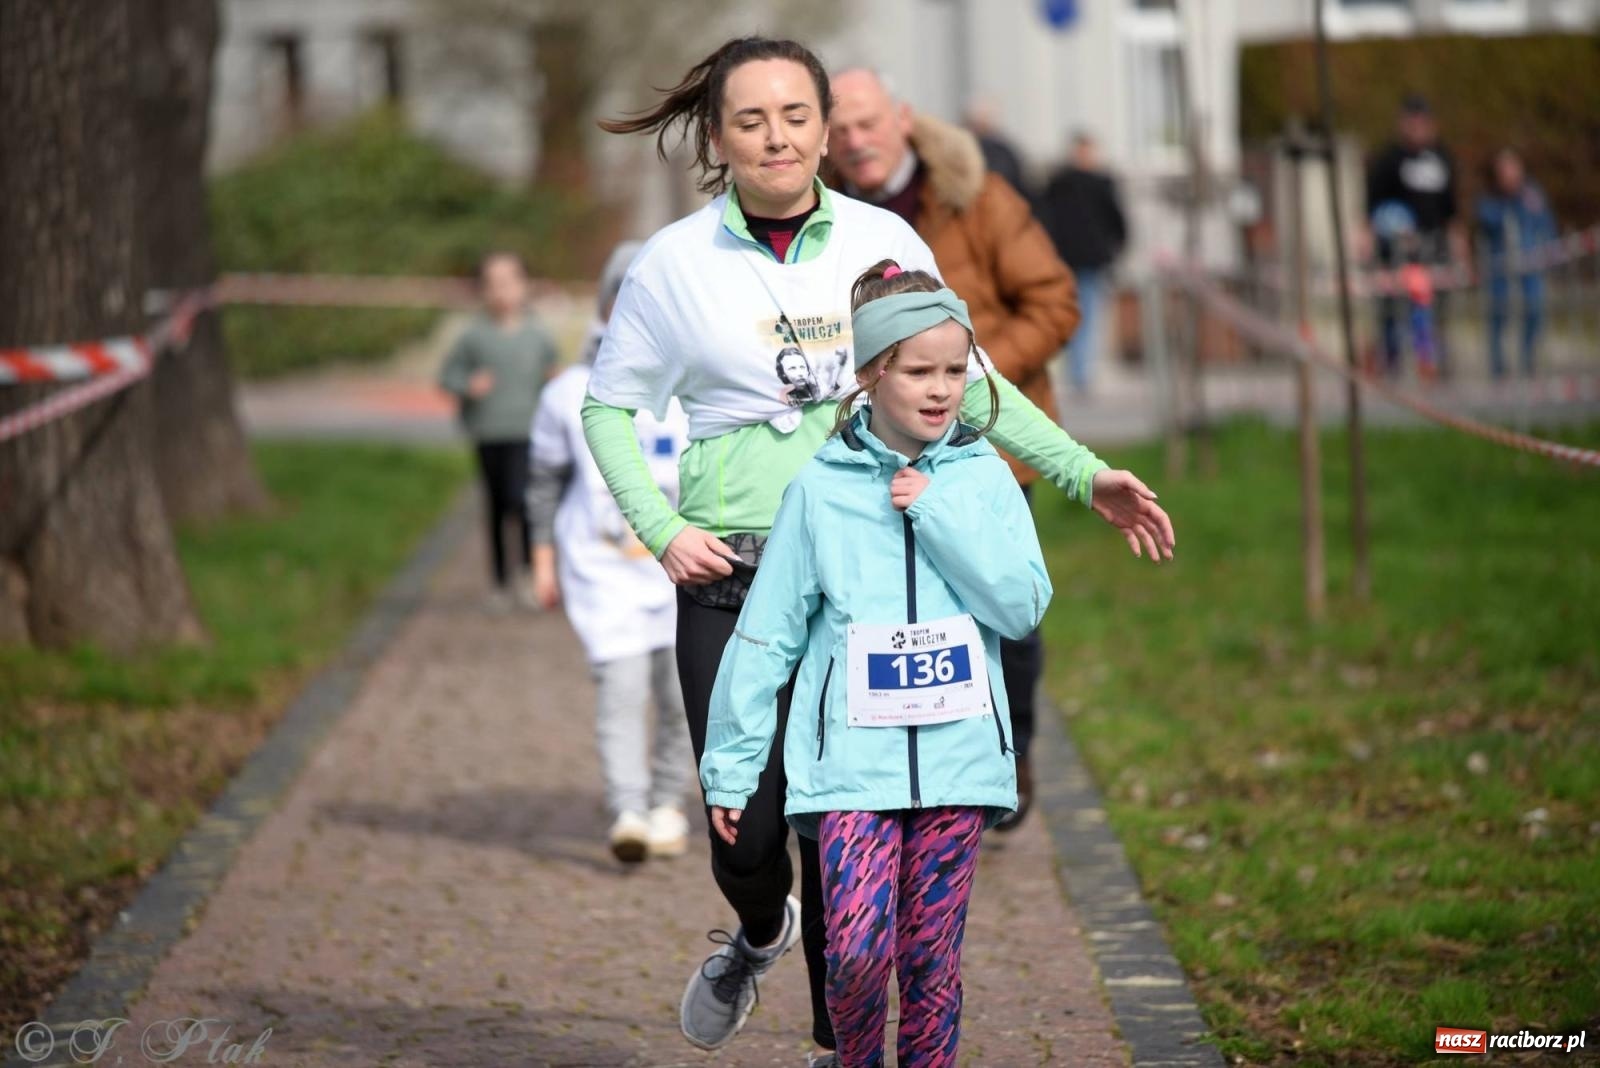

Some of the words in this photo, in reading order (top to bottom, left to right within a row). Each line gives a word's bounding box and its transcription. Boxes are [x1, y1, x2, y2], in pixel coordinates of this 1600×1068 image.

[793, 316, 824, 327] TROPEM
[911, 632, 947, 647] WILCZYM
[890, 649, 955, 687] 136
